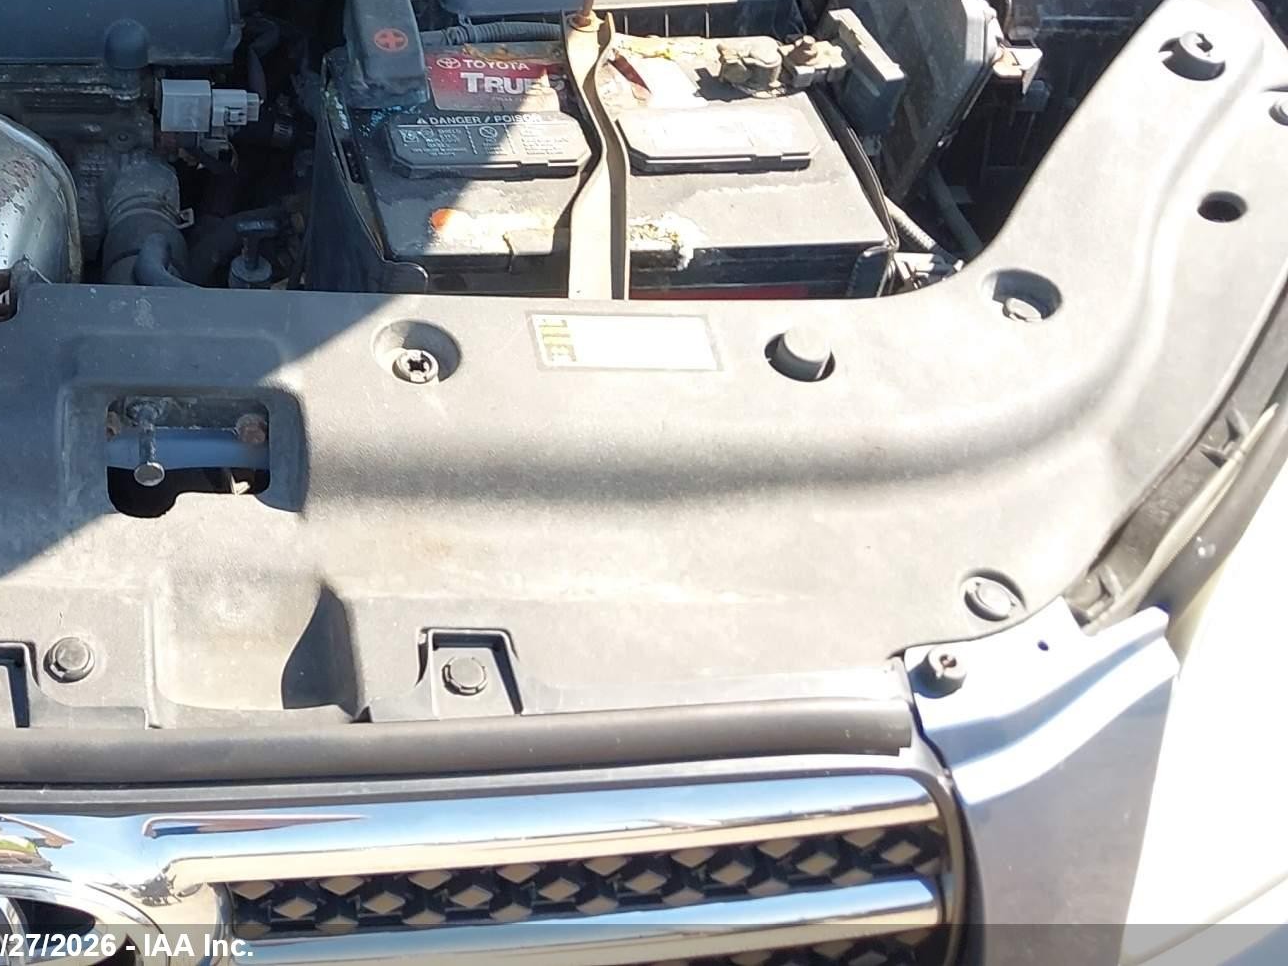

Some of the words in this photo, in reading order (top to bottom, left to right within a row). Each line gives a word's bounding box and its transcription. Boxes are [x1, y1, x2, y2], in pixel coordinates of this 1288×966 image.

[462, 59, 530, 71] TOYOTA
[429, 115, 481, 125] DANGER
[494, 114, 542, 123] POISON
